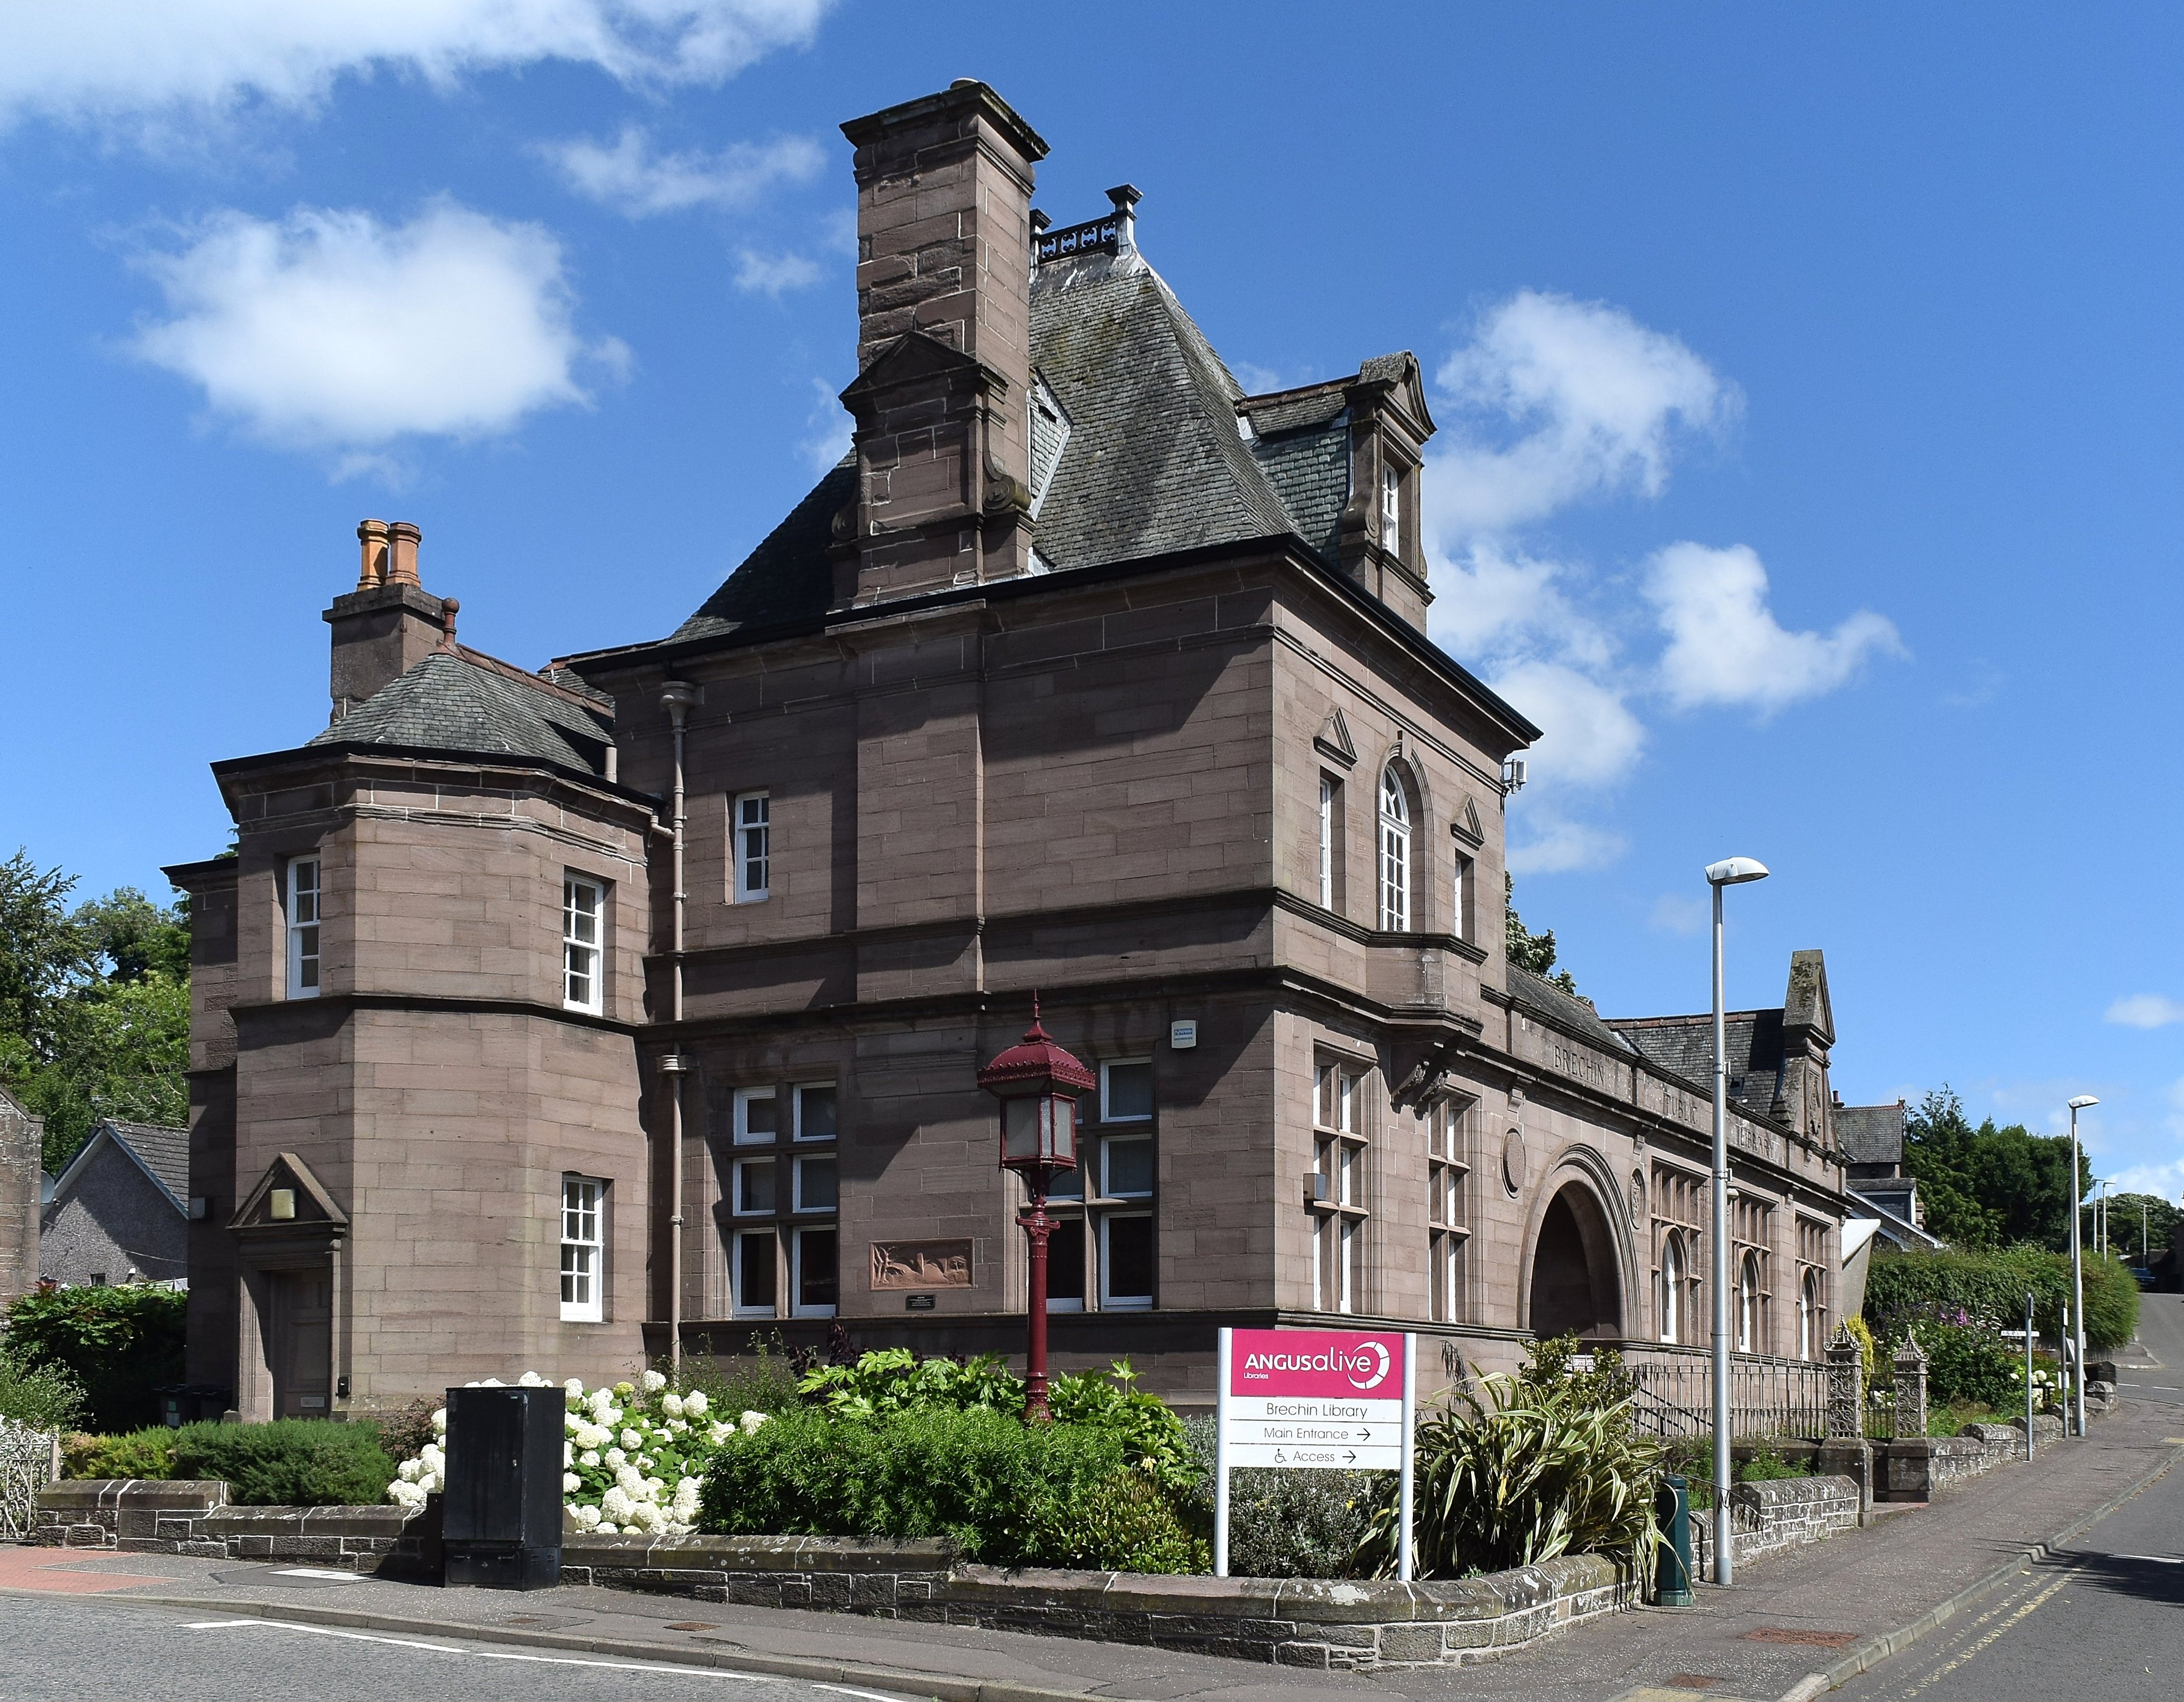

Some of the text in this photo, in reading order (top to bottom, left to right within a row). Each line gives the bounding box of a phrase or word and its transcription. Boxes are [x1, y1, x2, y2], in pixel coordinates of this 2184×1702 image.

[1554, 1045, 1774, 1158] BRECHIN PUBLIC LIBRARY
[1244, 1346, 1372, 1372] ANGUSalive
[1267, 1402, 1368, 1420] Brechin Library
[1264, 1428, 1349, 1440] Main Entrance
[1293, 1451, 1335, 1462] Access
